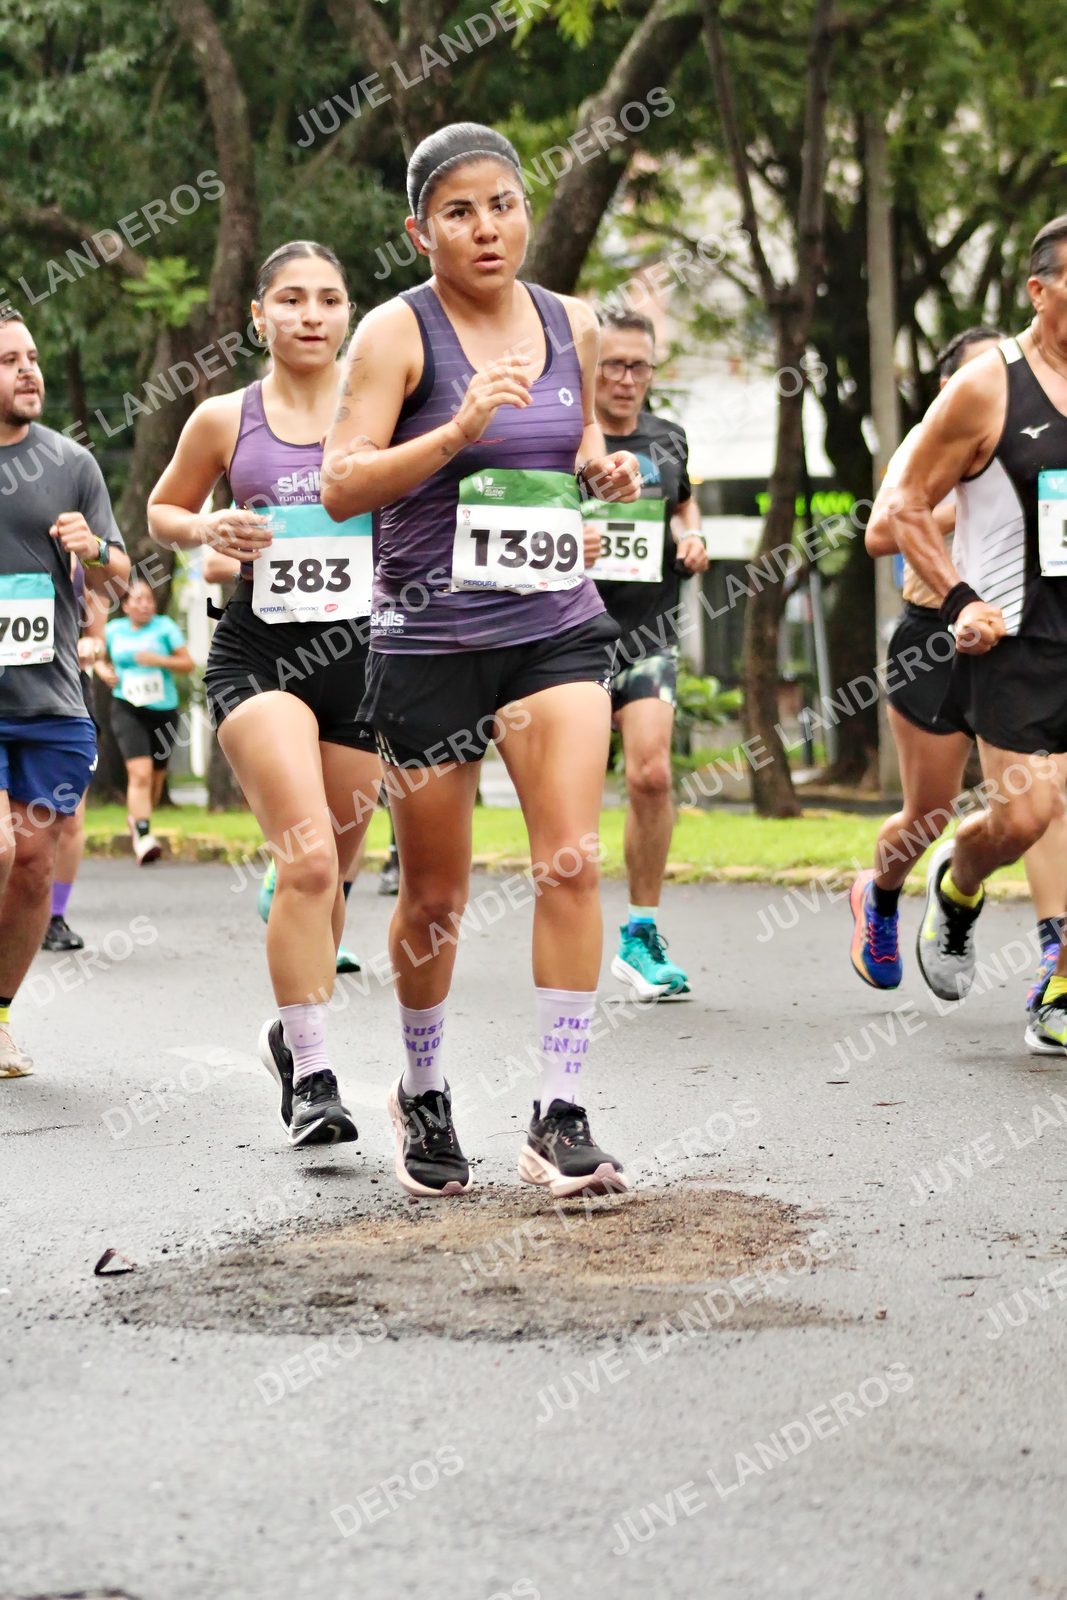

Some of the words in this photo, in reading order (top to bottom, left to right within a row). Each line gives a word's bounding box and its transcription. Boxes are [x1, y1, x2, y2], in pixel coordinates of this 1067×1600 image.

[279, 493, 317, 502] running
[470, 529, 578, 573] 1399
[269, 558, 351, 594] 383
[370, 611, 405, 626] skills
[0, 616, 49, 642] 709
[416, 1055, 434, 1067] IT
[565, 1061, 582, 1074] IT
